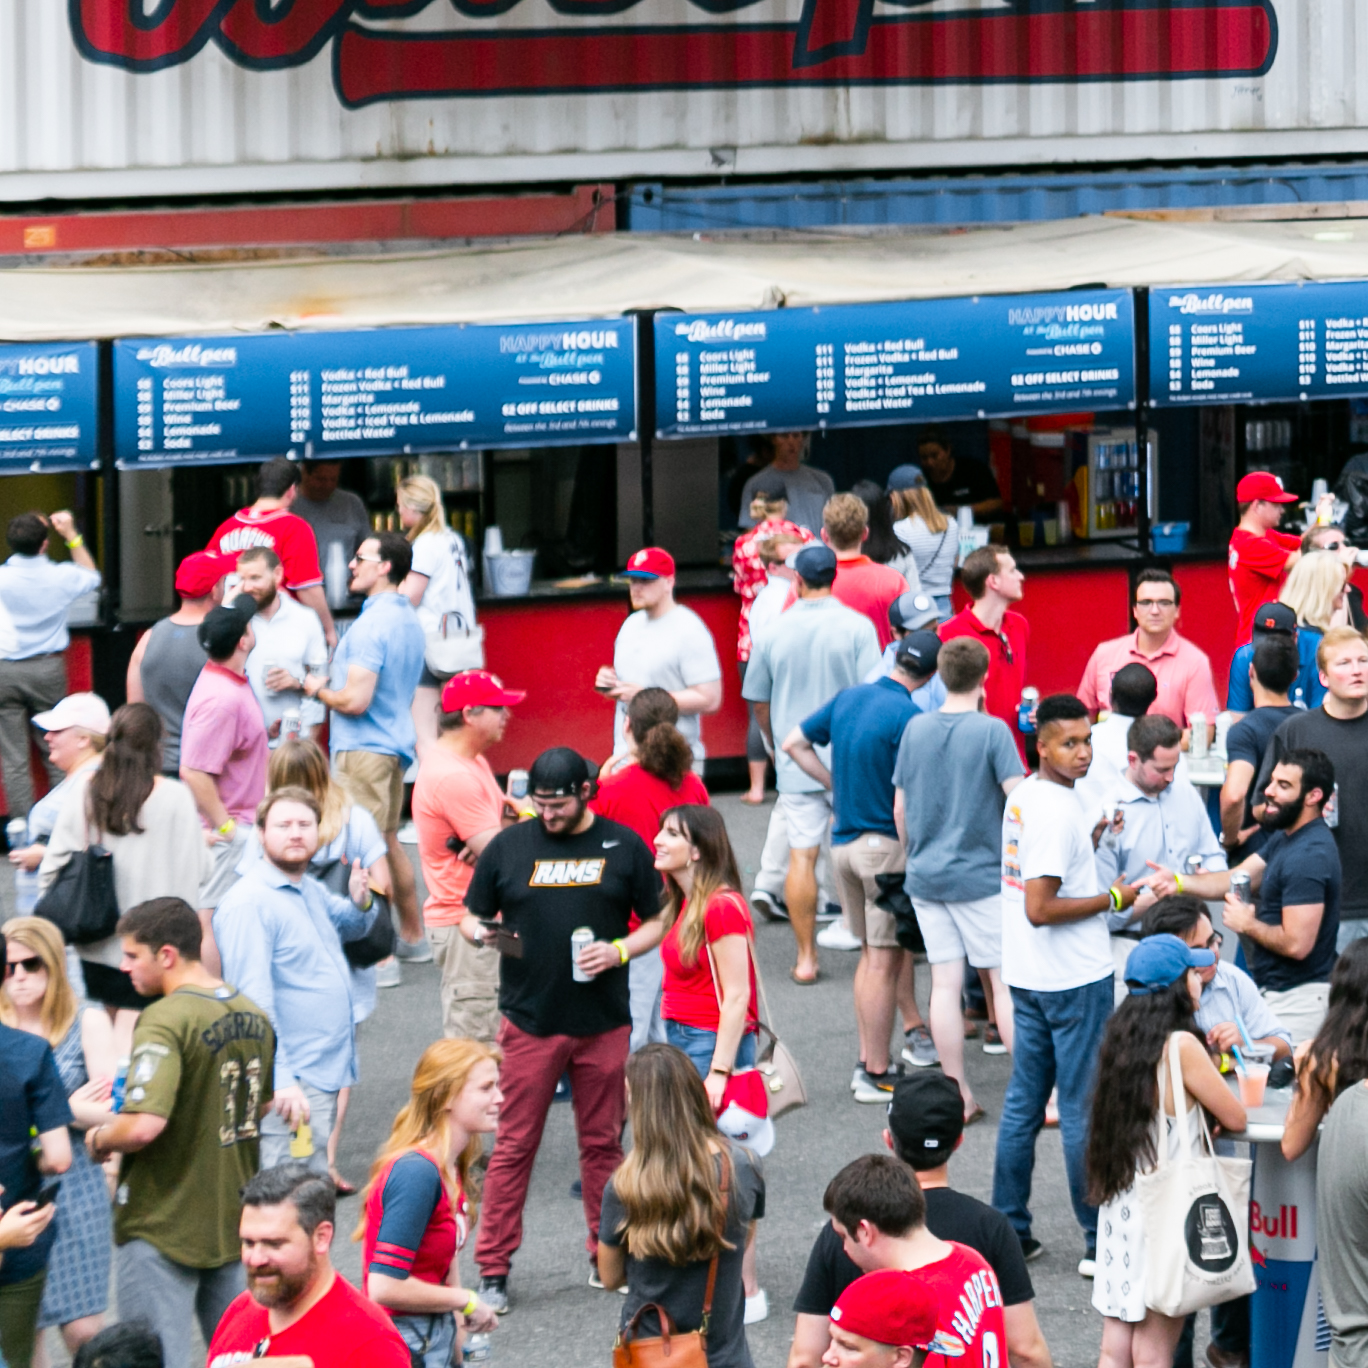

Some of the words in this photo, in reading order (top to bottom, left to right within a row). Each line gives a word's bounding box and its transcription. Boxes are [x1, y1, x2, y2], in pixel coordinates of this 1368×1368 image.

[18, 354, 79, 375] HOUR
[151, 344, 236, 368] Bullpen
[534, 859, 602, 885] RAMS
